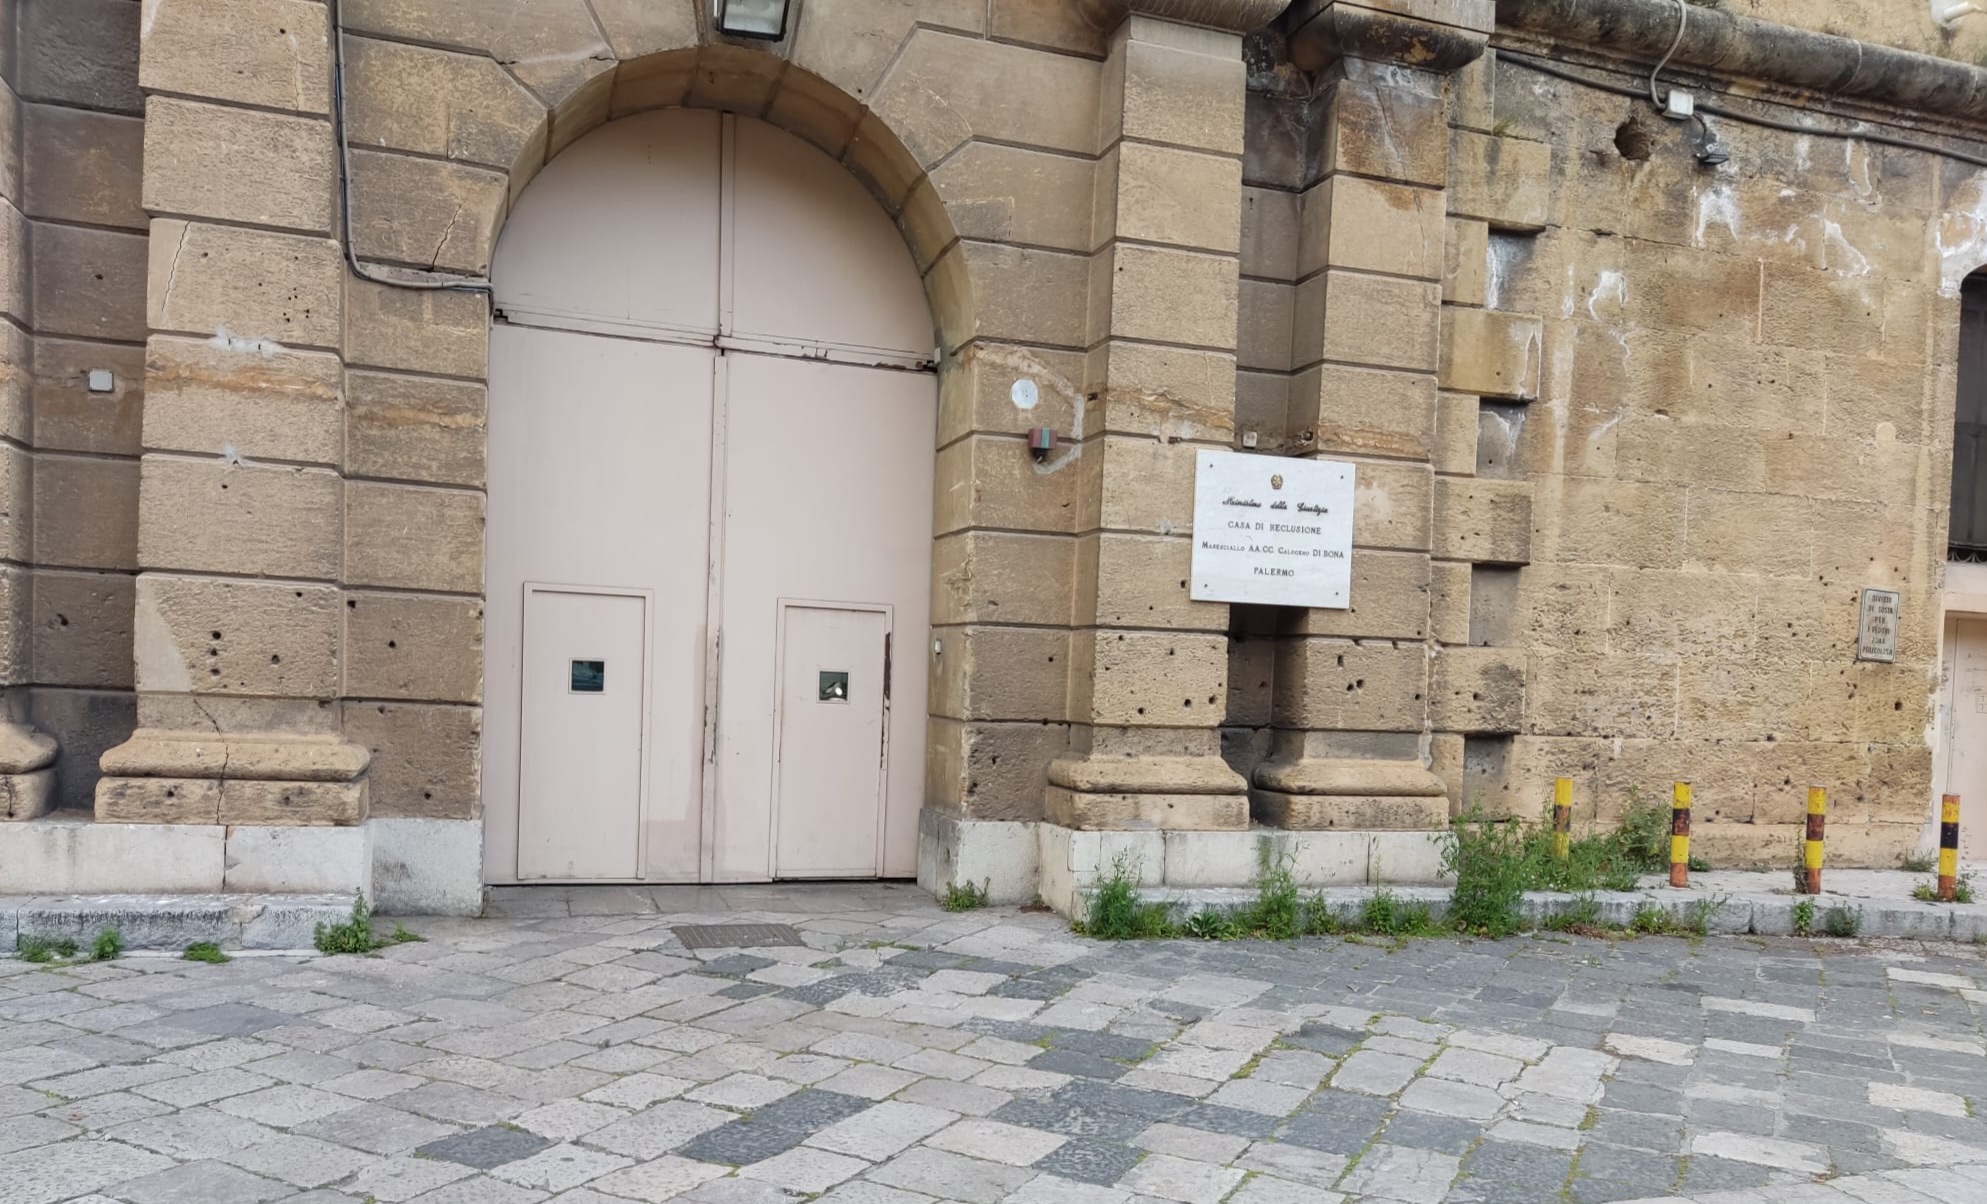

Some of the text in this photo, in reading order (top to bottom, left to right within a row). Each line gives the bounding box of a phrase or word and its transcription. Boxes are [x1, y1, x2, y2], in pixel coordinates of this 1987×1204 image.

[1270, 500, 1288, 510] della
[1297, 502, 1329, 516] Giustizia
[1228, 521, 1322, 535] CASA DI RECLUSIONE
[1312, 549, 1321, 557] DI
[1323, 550, 1344, 559] BONA
[1253, 567, 1295, 577] PALERMO
[1878, 606, 1893, 614] SOSTA
[1874, 616, 1886, 624] PER
[1871, 637, 1886, 645] ZONA
[1862, 646, 1893, 656] PERICOLOSA
